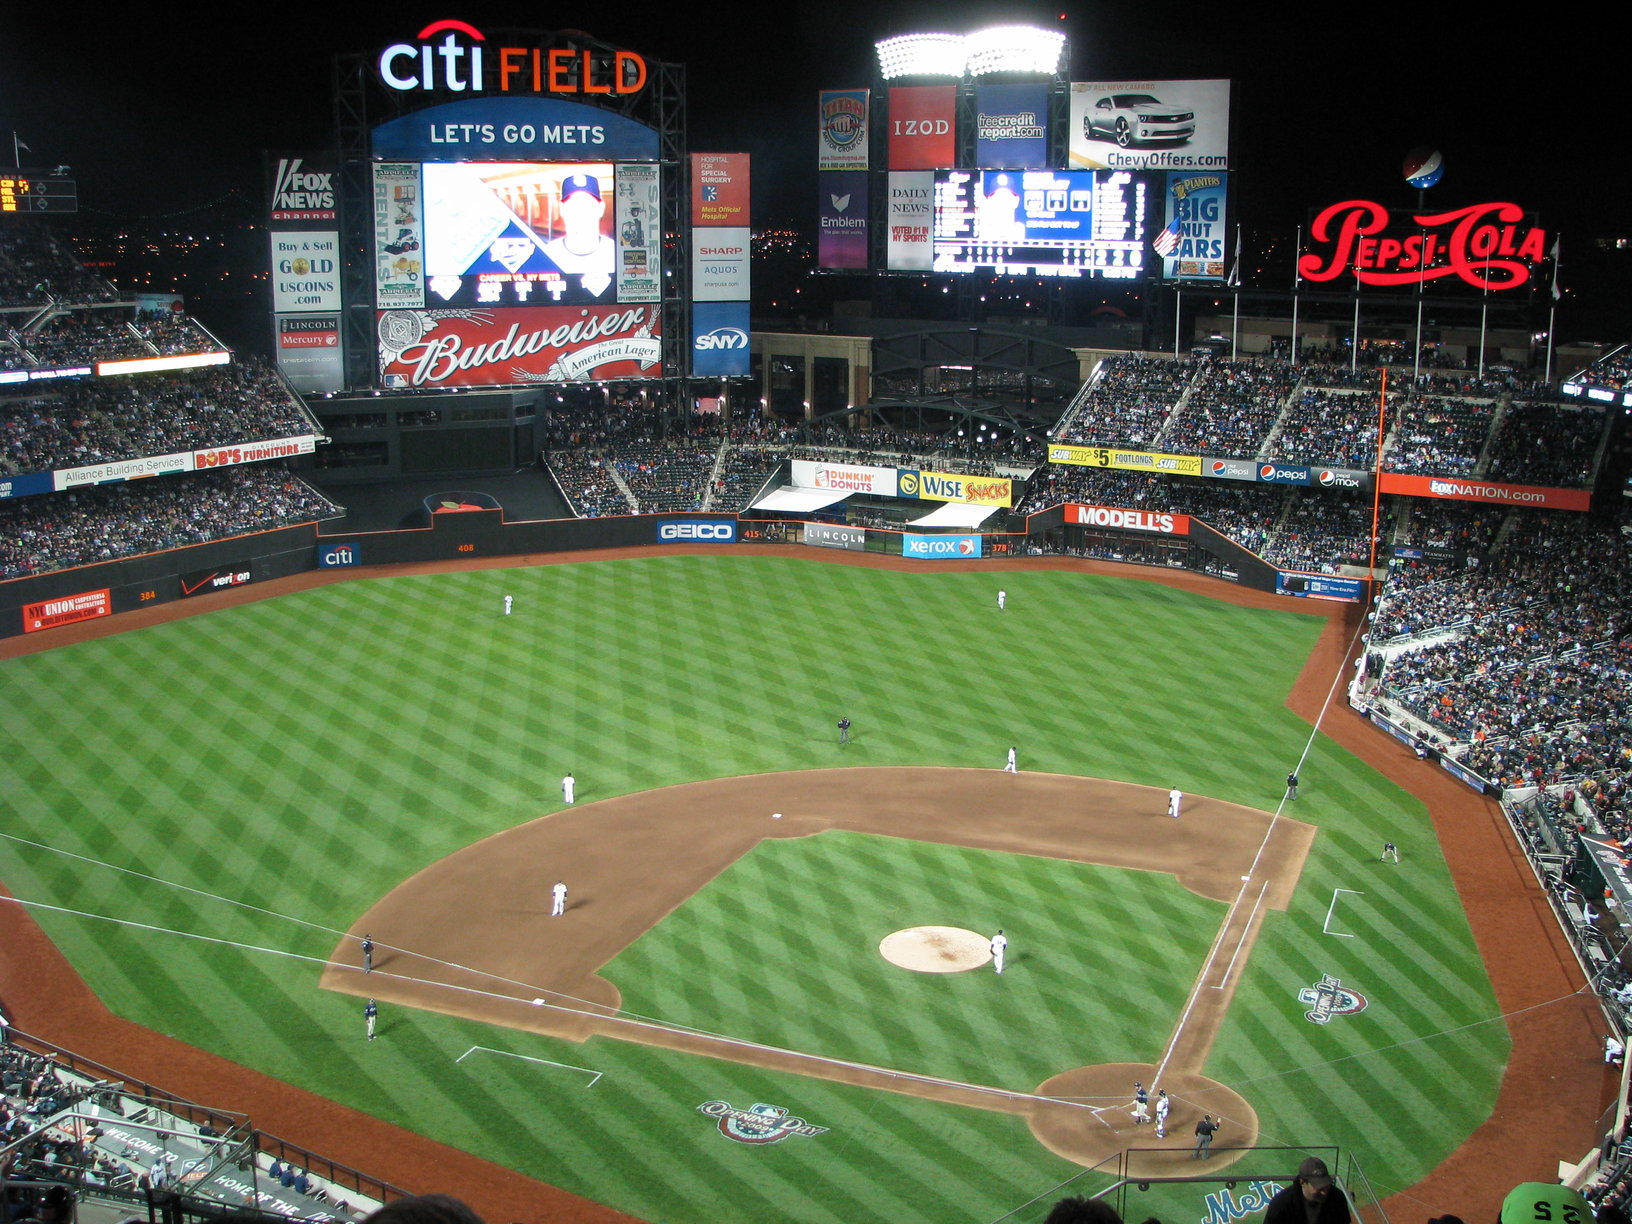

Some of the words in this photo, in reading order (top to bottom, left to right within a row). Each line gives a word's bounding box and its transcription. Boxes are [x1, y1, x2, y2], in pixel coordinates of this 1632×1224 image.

[379, 33, 484, 92] citi
[500, 47, 648, 94] FIELD
[978, 112, 1036, 127] freecredit
[430, 124, 496, 144] LET'S
[503, 125, 536, 144] GO
[543, 125, 605, 144] METS
[894, 119, 949, 136] IZOD
[1107, 152, 1227, 169] ChevyOffers.com
[292, 173, 333, 191] FOX
[1184, 177, 1221, 190] PLANTERS
[279, 192, 335, 209] NEWS
[892, 189, 929, 198] DAILY
[892, 203, 930, 213] NEWS
[1173, 197, 1219, 222] BIG
[273, 212, 336, 220] channel
[821, 216, 866, 228] Emblem
[376, 183, 390, 282] RENTALS
[648, 184, 660, 276] SALES
[891, 225, 912, 235] VOTED
[1181, 223, 1212, 238] NUT
[902, 234, 928, 243] SPORTS
[278, 242, 299, 253] Buy
[302, 242, 310, 251] &
[313, 241, 333, 251] Sell
[700, 247, 743, 255] SHARP
[704, 266, 738, 275] AQUOS
[280, 281, 334, 293] USCOINS
[293, 294, 322, 305] .com
[290, 321, 336, 330] LINCOLN
[283, 335, 324, 345] Mercury
[396, 307, 645, 386] Budweiser
[694, 334, 740, 350] SNY
[571, 346, 622, 373] American
[625, 344, 657, 357] Lager
[195, 448, 241, 469] BOB'S
[243, 444, 300, 461] FURNITURE
[1050, 449, 1092, 462] SUBWAY
[1114, 453, 1154, 466] FOOTLONGS
[1156, 458, 1200, 471] SUBWAY
[65, 466, 104, 483] Alliance
[106, 462, 145, 478] Building
[147, 456, 185, 471] Services
[830, 469, 875, 483] DUNKIN'
[1227, 467, 1249, 476] pepsi
[1276, 470, 1307, 481] pepsi
[830, 479, 873, 492] DONUTS
[922, 476, 962, 498] WISE
[965, 481, 1010, 502] SNACKS
[1335, 478, 1360, 488] max
[1078, 506, 1174, 533] MODELL'S
[660, 524, 733, 539] GEICO
[744, 530, 760, 538] 415
[809, 529, 865, 544] LINCOLN
[458, 544, 474, 553] 408
[909, 540, 956, 553] xerox
[992, 544, 1007, 552] 378
[325, 549, 353, 566] citi
[213, 570, 251, 588] verizon
[139, 590, 156, 601] 384
[45, 599, 75, 616] UNION
[704, 1102, 777, 1126] OPENING
[780, 1118, 823, 1135] DAY
[741, 1120, 770, 1131] 2009
[105, 1126, 164, 1156] WELCOME
[163, 1150, 179, 1163] TO
[214, 1175, 255, 1196] HOME
[251, 1191, 274, 1205] OF
[270, 1198, 301, 1216] THE
